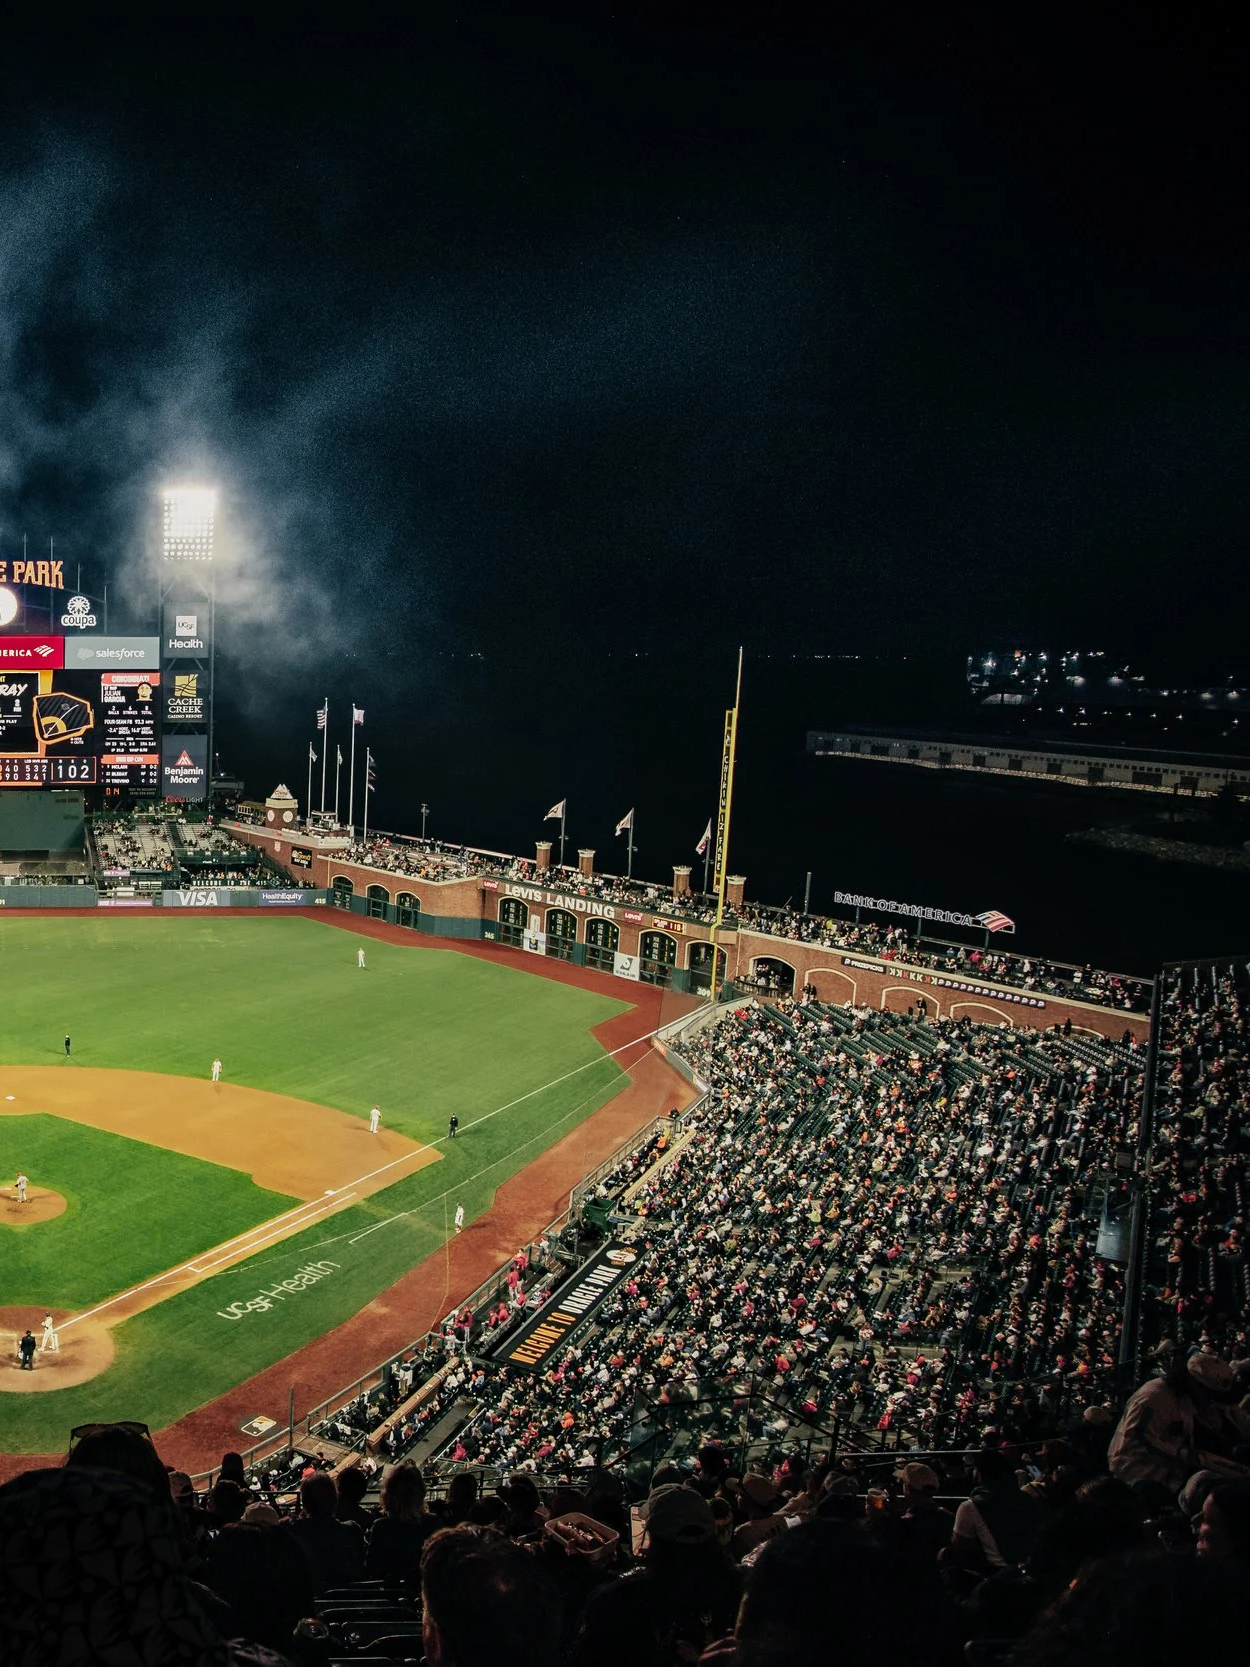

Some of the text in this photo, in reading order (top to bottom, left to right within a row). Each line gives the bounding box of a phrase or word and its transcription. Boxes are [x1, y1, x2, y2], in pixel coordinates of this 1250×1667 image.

[13, 561, 64, 590] PARK
[62, 616, 96, 628] coupa
[169, 639, 203, 648] Health
[96, 648, 145, 660] salesforce
[164, 767, 204, 776] Benjamin
[176, 891, 218, 906] VISA
[262, 893, 302, 901] HealthEquity
[549, 892, 616, 919] LANDING
[834, 891, 971, 926] BANK OF AMERICA
[484, 932, 494, 940] 365
[851, 960, 884, 973] PRIZEPICKS
[697, 987, 710, 997] 309
[216, 1260, 341, 1320] UCSF Health
[510, 1264, 622, 1365] WELCOME TO ORACLE PARK
